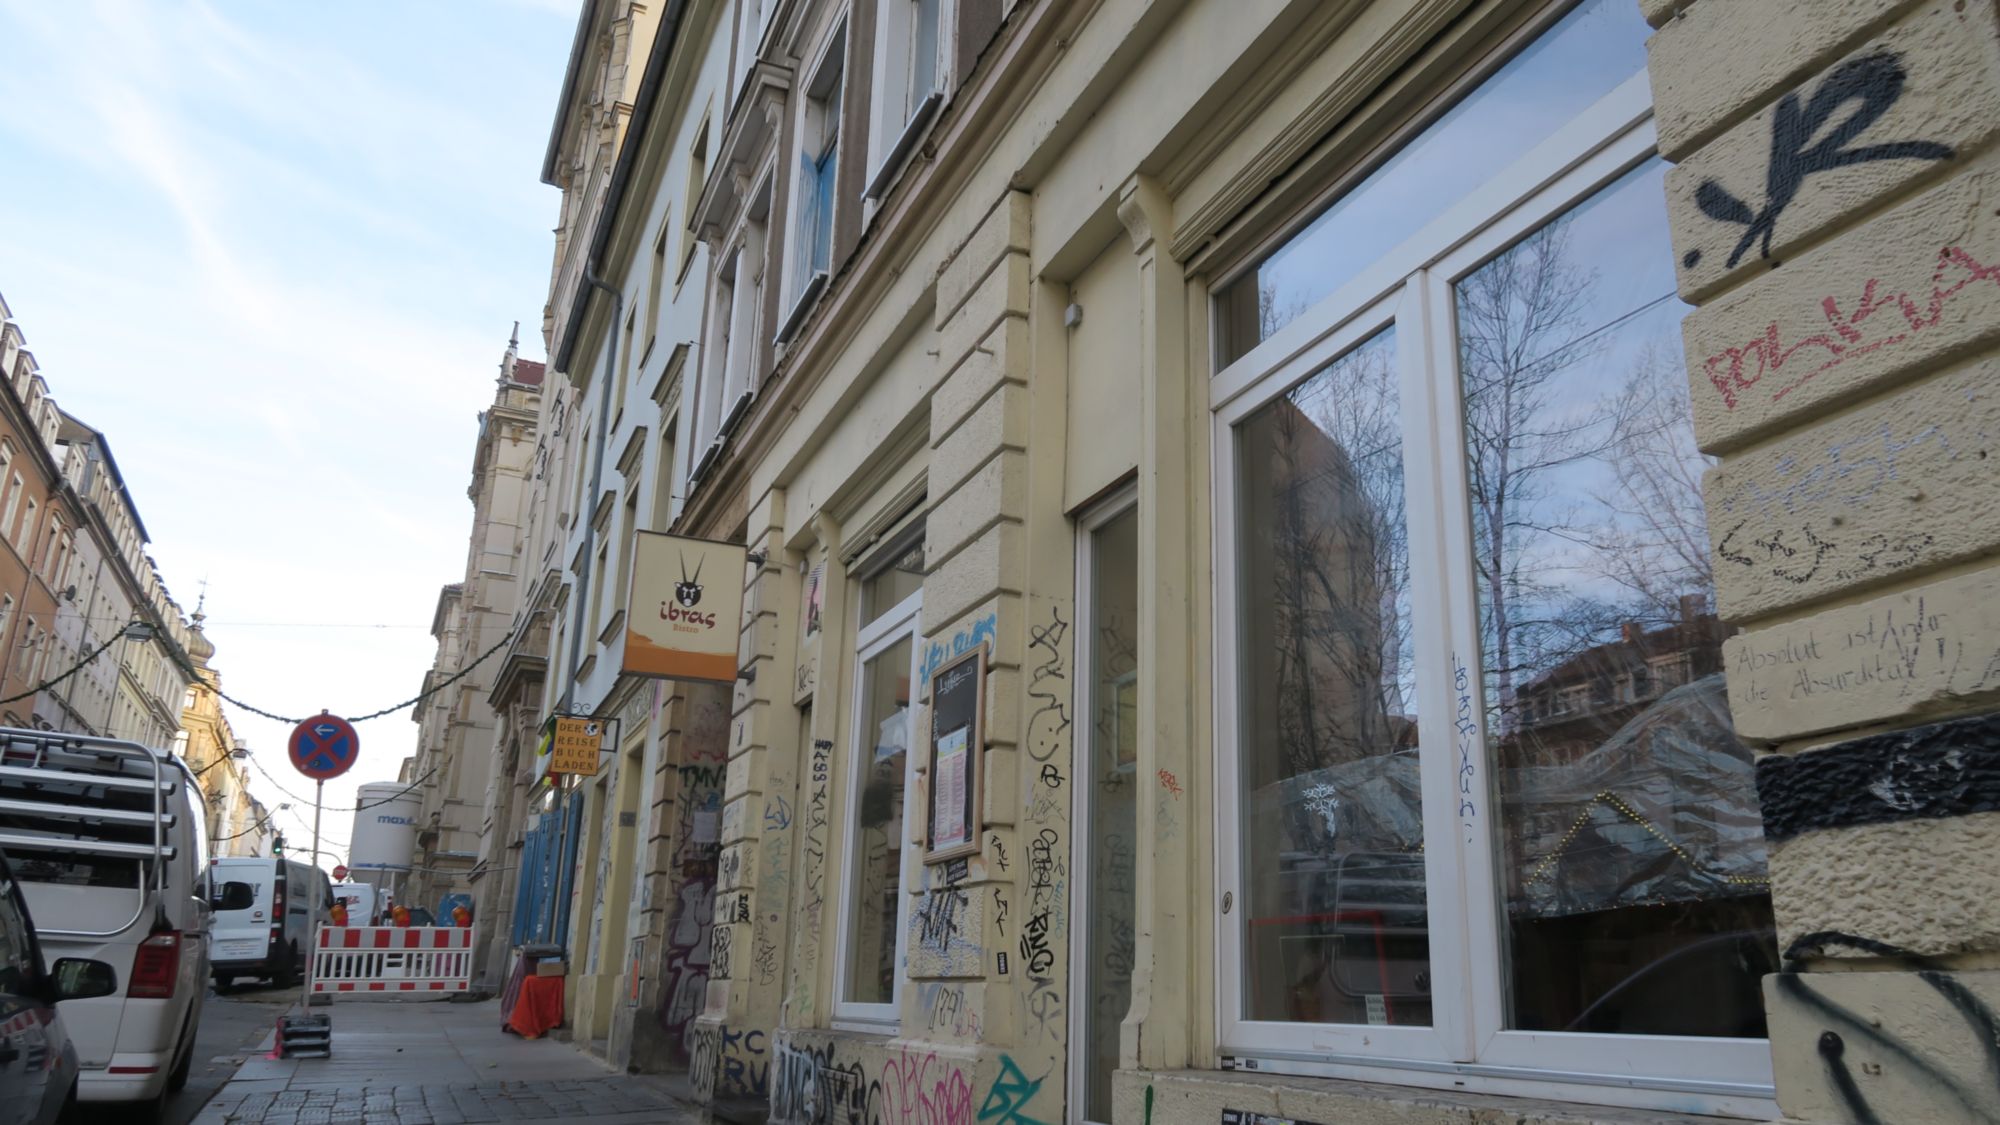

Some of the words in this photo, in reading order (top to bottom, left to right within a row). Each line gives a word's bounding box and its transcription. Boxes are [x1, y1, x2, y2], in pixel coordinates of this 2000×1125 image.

[660, 600, 716, 630] ibras
[672, 623, 700, 634] Bistro
[1736, 630, 1823, 675] Absolut
[1744, 680, 1769, 702] die
[559, 722, 582, 733] DER
[557, 735, 597, 748] REISE
[556, 748, 596, 760] BUCH
[554, 759, 595, 771] LADEN
